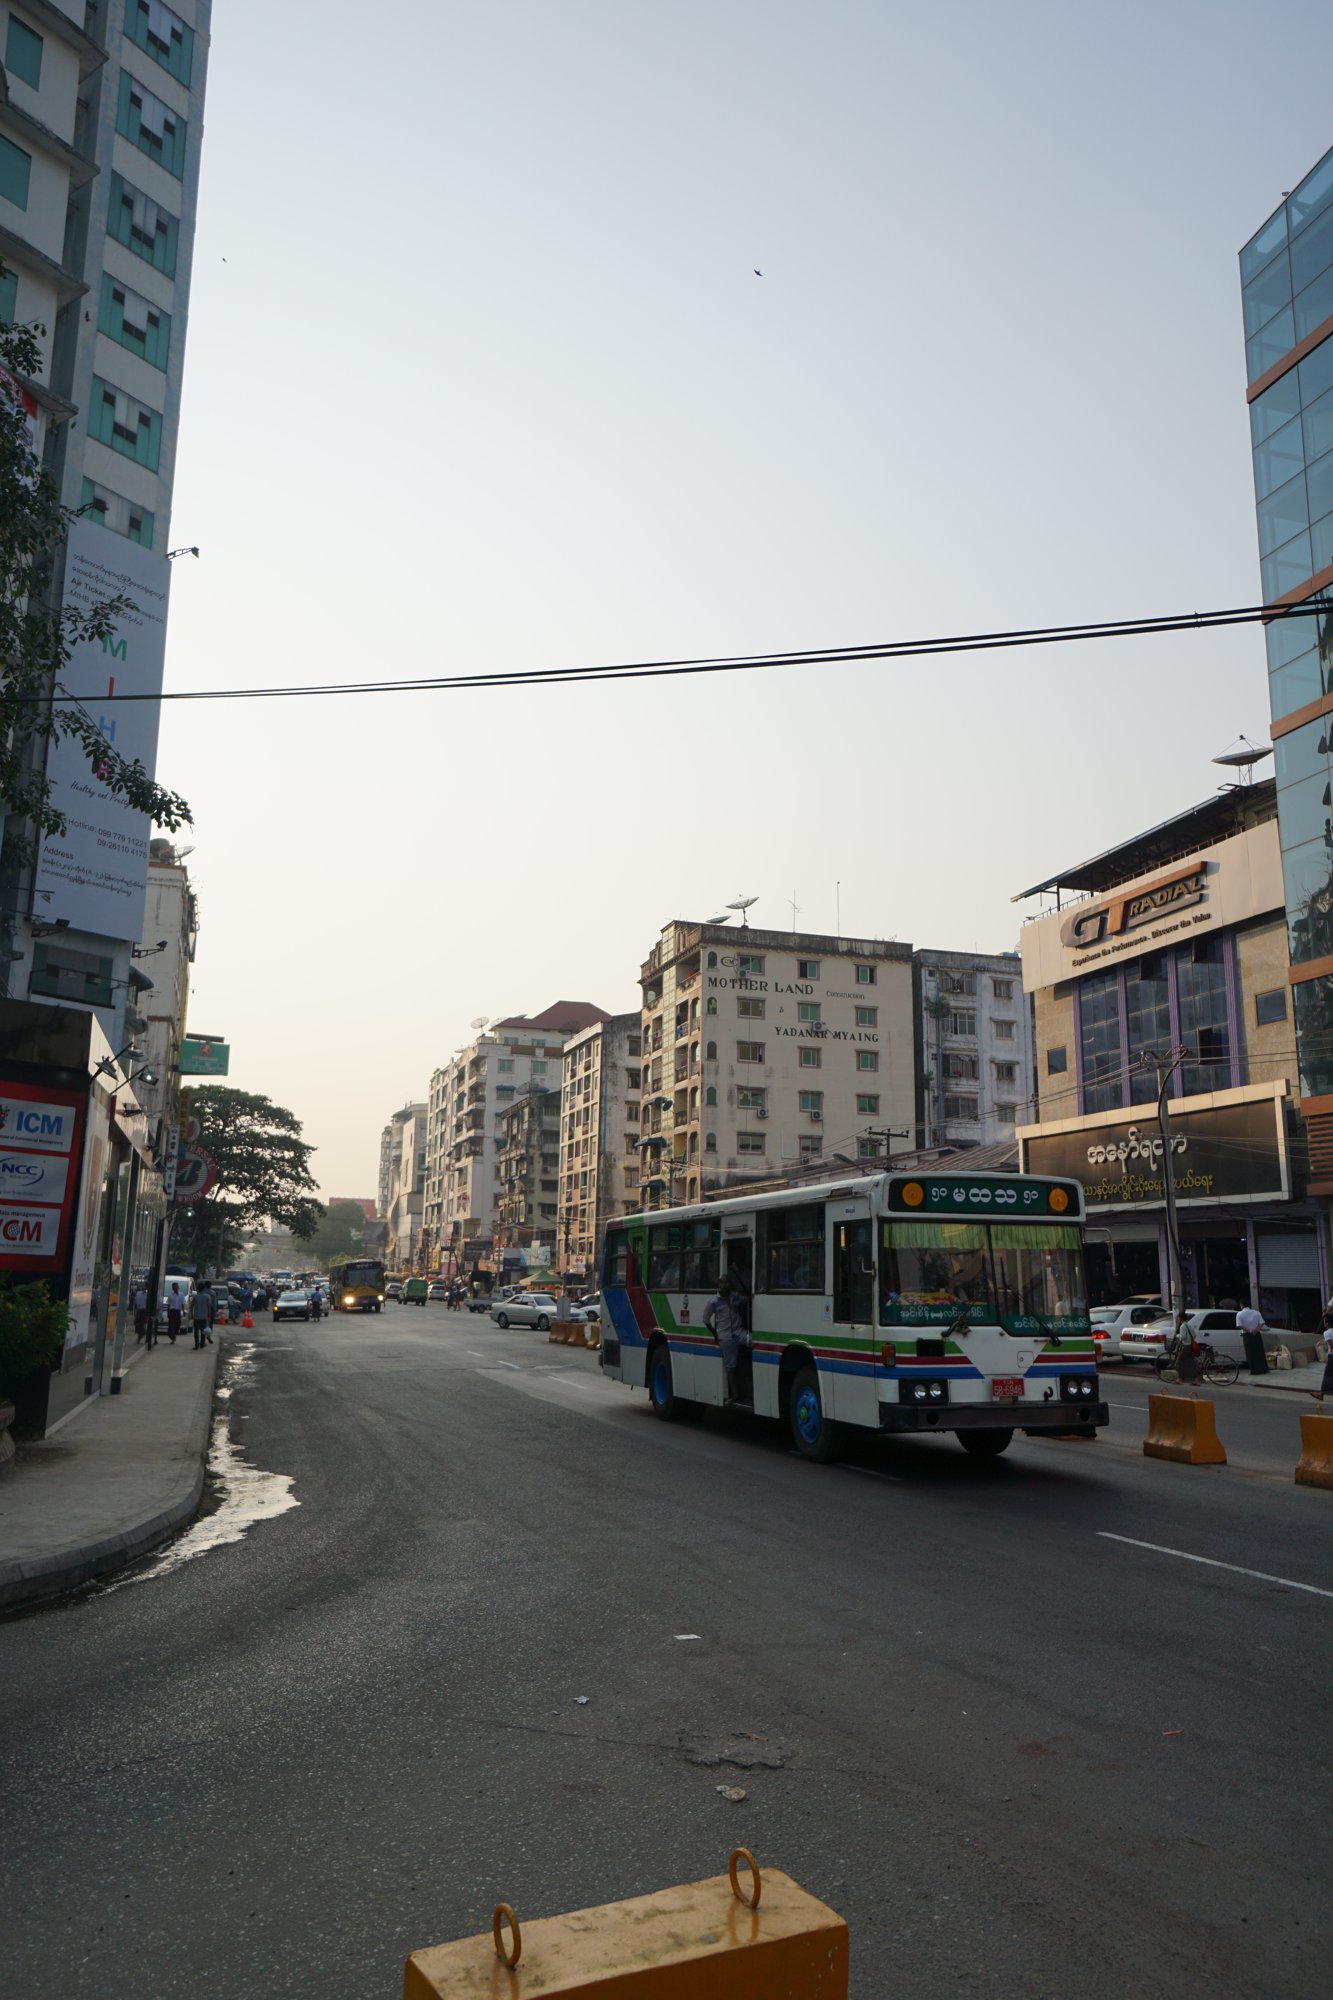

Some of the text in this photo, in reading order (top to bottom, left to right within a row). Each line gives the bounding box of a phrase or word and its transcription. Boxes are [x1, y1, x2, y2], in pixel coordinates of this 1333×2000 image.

[84, 583, 106, 598] Ticket
[70, 781, 95, 798] Healthy
[69, 819, 96, 832] Hotline:
[99, 828, 112, 838] 099
[113, 832, 125, 842] 779
[44, 846, 73, 860] Address
[1130, 876, 1205, 917] RADIAL
[1152, 924, 1178, 938] Discover
[1180, 919, 1191, 929] the
[708, 977, 768, 992] MOTHER
[775, 982, 814, 995] LAND
[832, 1031, 879, 1043] MYAING
[16, 1111, 63, 1136] ICM
[1, 1163, 39, 1175] NCC
[10, 1210, 46, 1219] management
